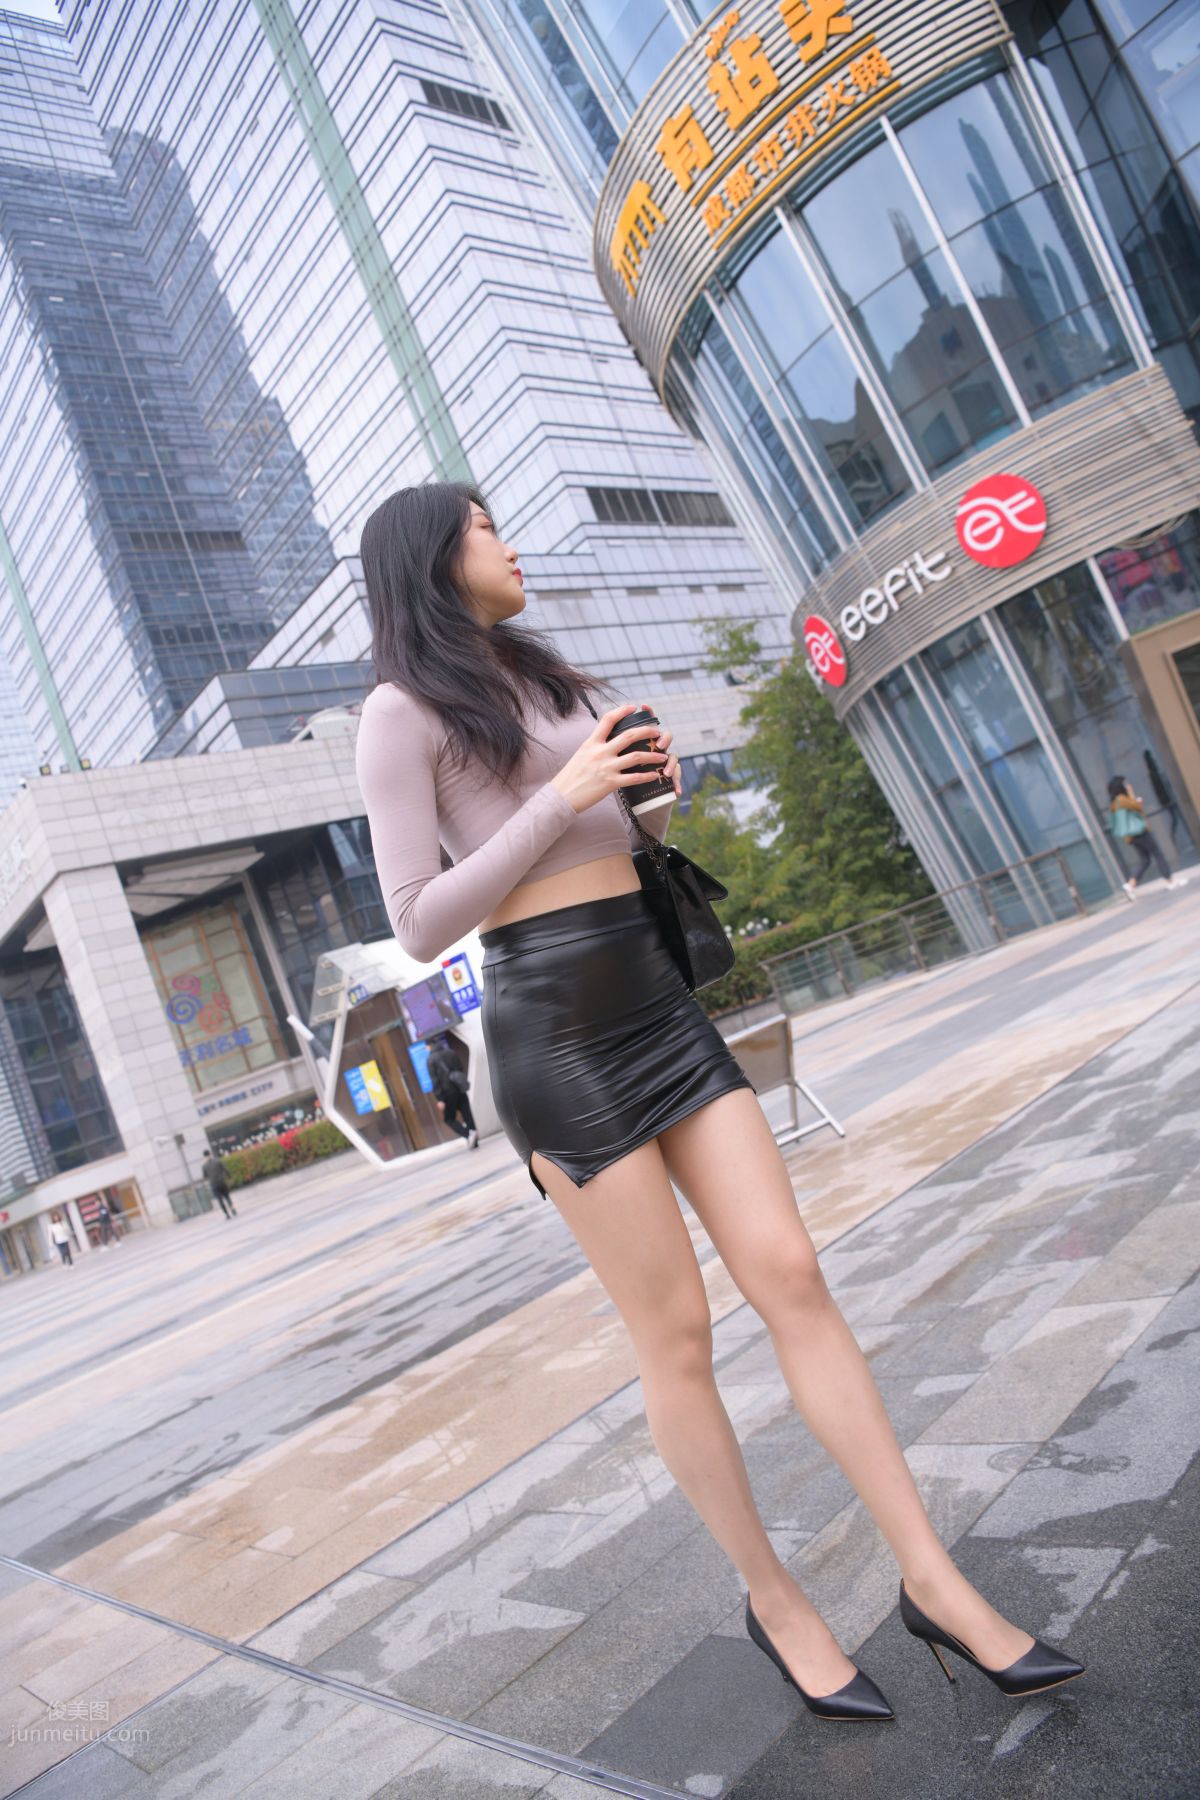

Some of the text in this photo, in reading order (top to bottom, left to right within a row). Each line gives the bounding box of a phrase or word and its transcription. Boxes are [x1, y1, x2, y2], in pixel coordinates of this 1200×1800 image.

[701, 45, 893, 236] 成都市井火锅
